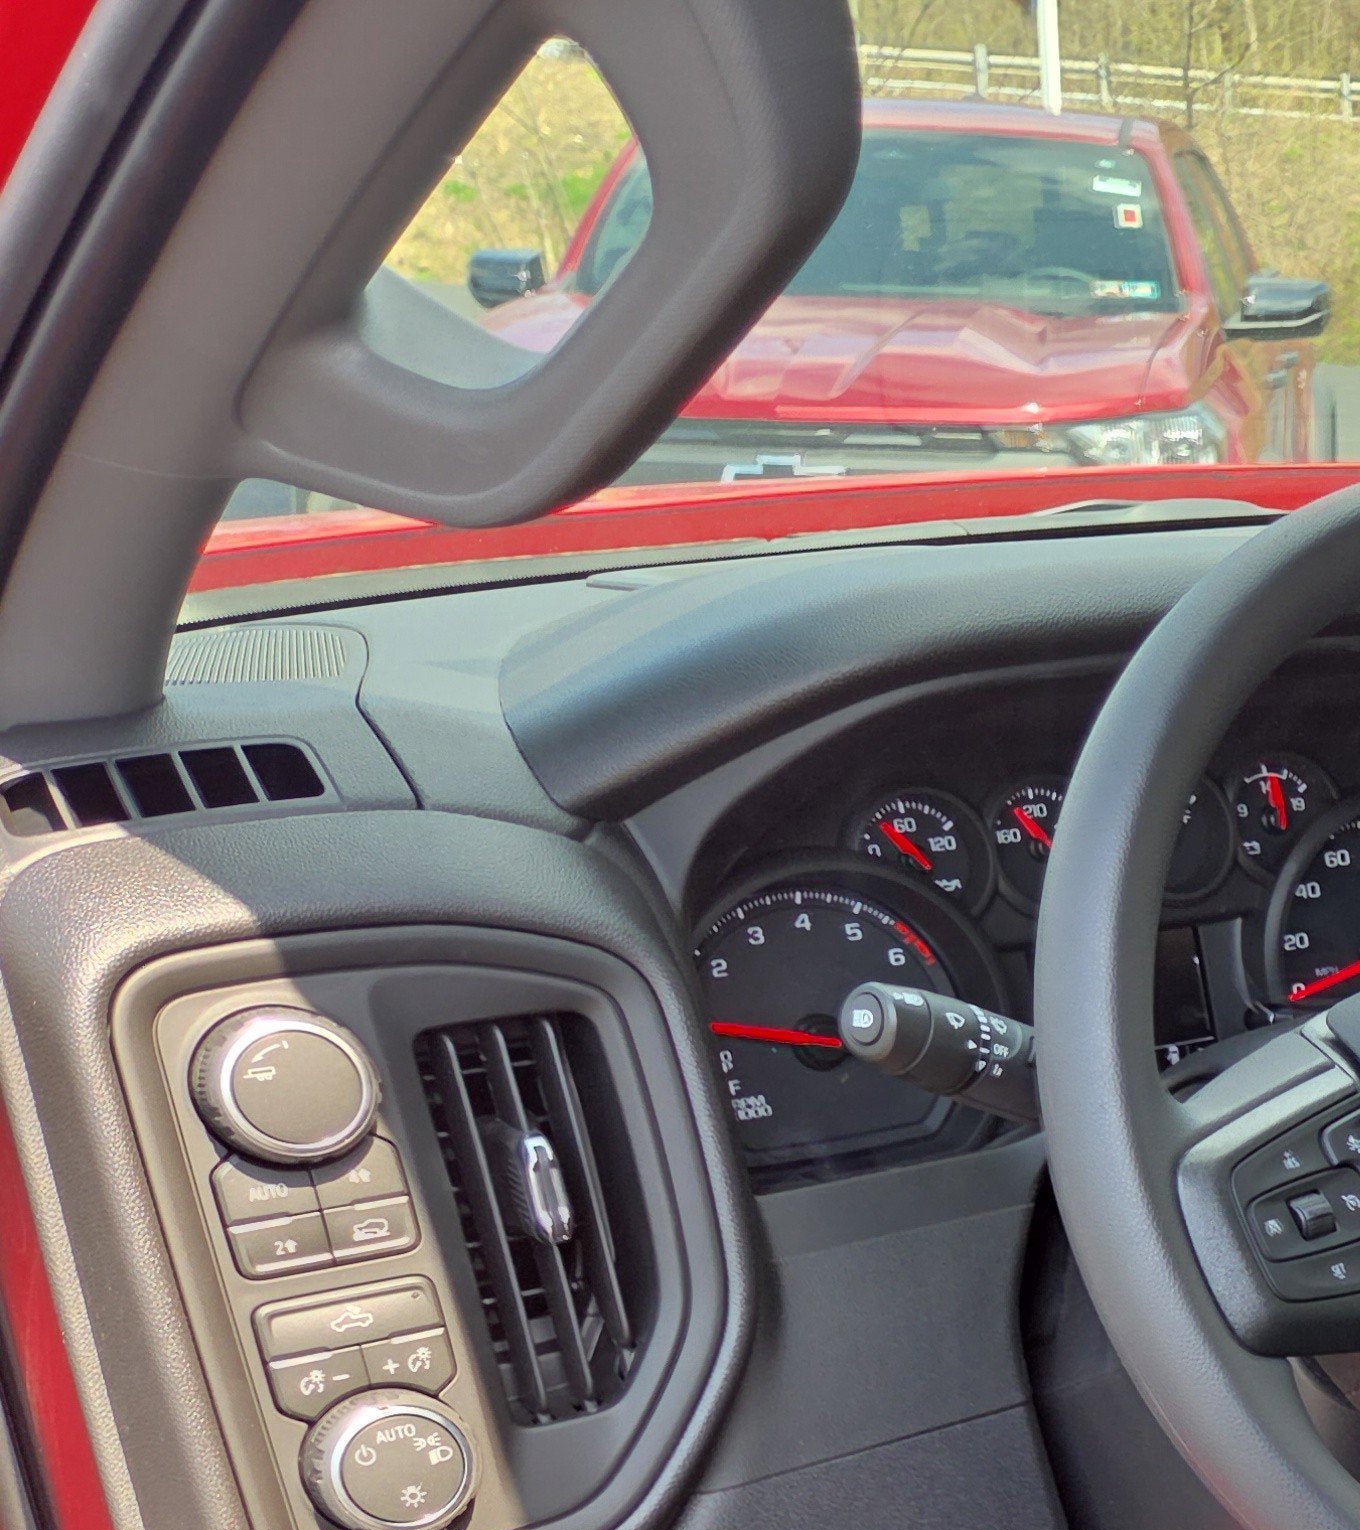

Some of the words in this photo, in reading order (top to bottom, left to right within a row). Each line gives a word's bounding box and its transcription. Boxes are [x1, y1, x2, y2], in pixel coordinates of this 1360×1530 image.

[1237, 803, 1249, 818] 9
[893, 817, 917, 834] 60
[927, 835, 957, 852] 120
[1324, 849, 1351, 868] 60
[1295, 881, 1322, 899] 40
[795, 913, 811, 931] 4
[845, 922, 863, 941] 5
[747, 926, 766, 945] 3
[1284, 932, 1309, 951] 20
[888, 947, 906, 966] 6
[710, 958, 729, 978] 2
[993, 1043, 1009, 1058] OFF
[249, 1182, 290, 1203] AUTO
[375, 1423, 417, 1444] AUTO
